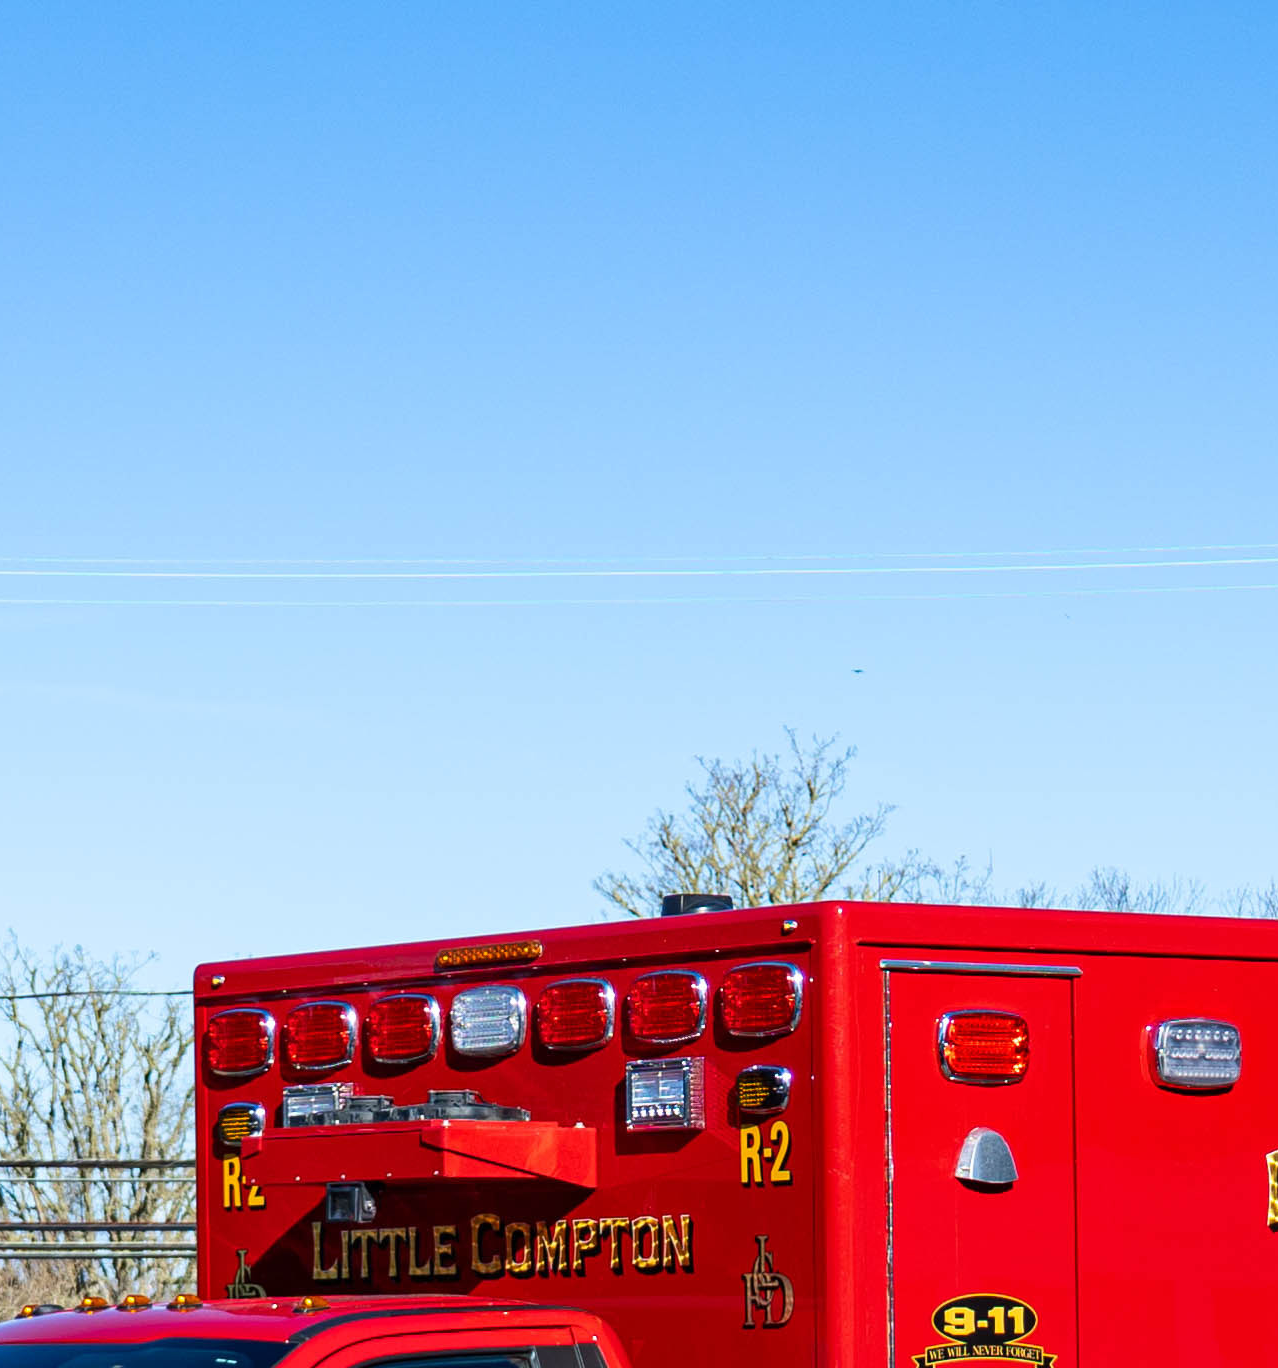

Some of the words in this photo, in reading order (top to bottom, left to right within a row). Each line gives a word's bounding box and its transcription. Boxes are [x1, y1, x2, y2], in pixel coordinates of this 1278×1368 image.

[740, 1120, 793, 1185] R-2
[310, 1221, 458, 1281] LITTLE
[470, 1213, 693, 1276] COMPTON
[943, 1306, 1025, 1336] 9-11
[929, 1348, 945, 1361] WE
[947, 1345, 971, 1358] WILL
[973, 1345, 1004, 1357] NEVER
[1006, 1345, 1041, 1361] FORGET
